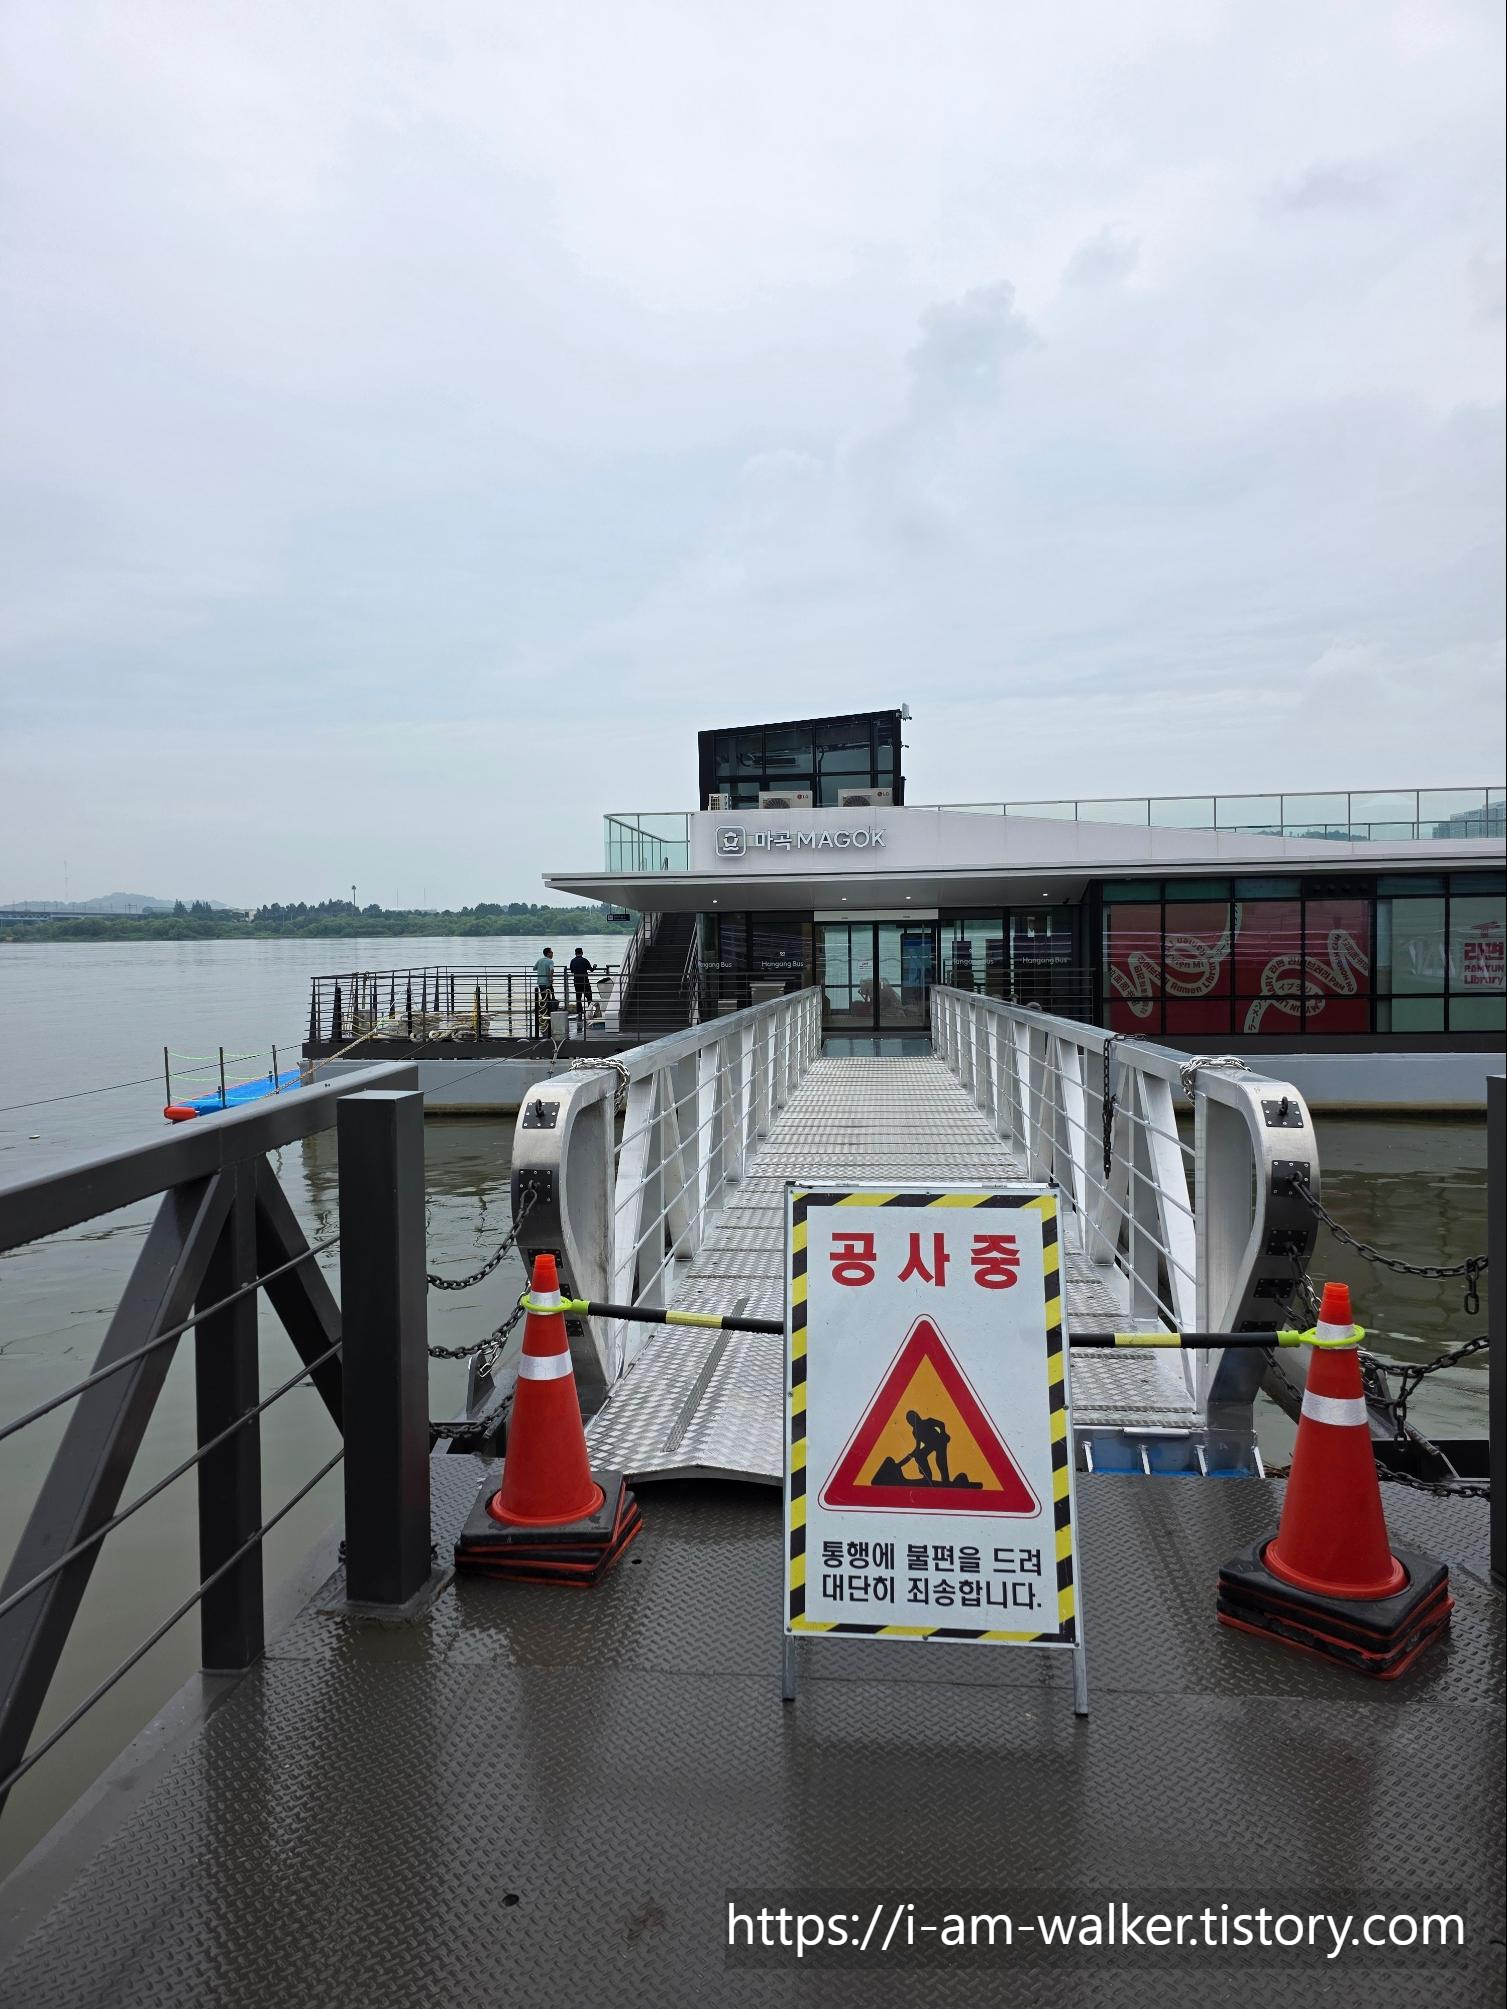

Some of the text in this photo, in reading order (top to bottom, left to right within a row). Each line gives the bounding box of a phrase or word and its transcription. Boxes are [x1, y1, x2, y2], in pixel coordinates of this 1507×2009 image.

[755, 829, 887, 851] 마곡 MAGOK
[1464, 942, 1504, 961] 라면
[761, 961, 791, 969] Hangang
[1464, 975, 1504, 986] Library
[821, 1541, 1042, 1576] 통행에 불편을 드려
[822, 1574, 1042, 1610] 대단히 죄송합니다.
